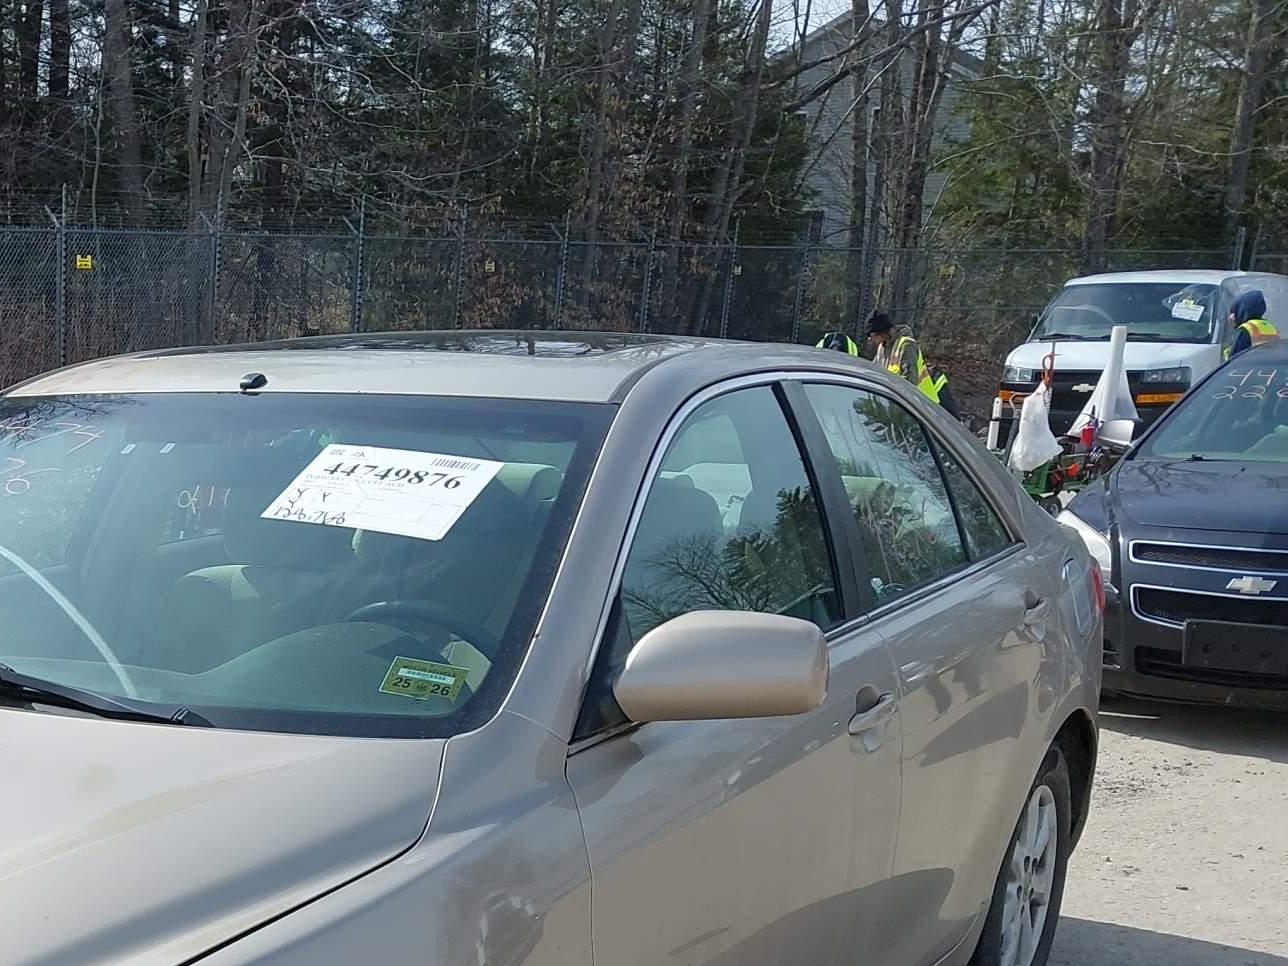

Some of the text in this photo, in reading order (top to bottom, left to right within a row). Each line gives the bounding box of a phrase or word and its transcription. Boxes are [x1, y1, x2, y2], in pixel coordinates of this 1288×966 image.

[1228, 369, 1288, 387] 44
[323, 461, 465, 490] 44749876
[392, 676, 413, 689] 25
[430, 683, 452, 696] 26
